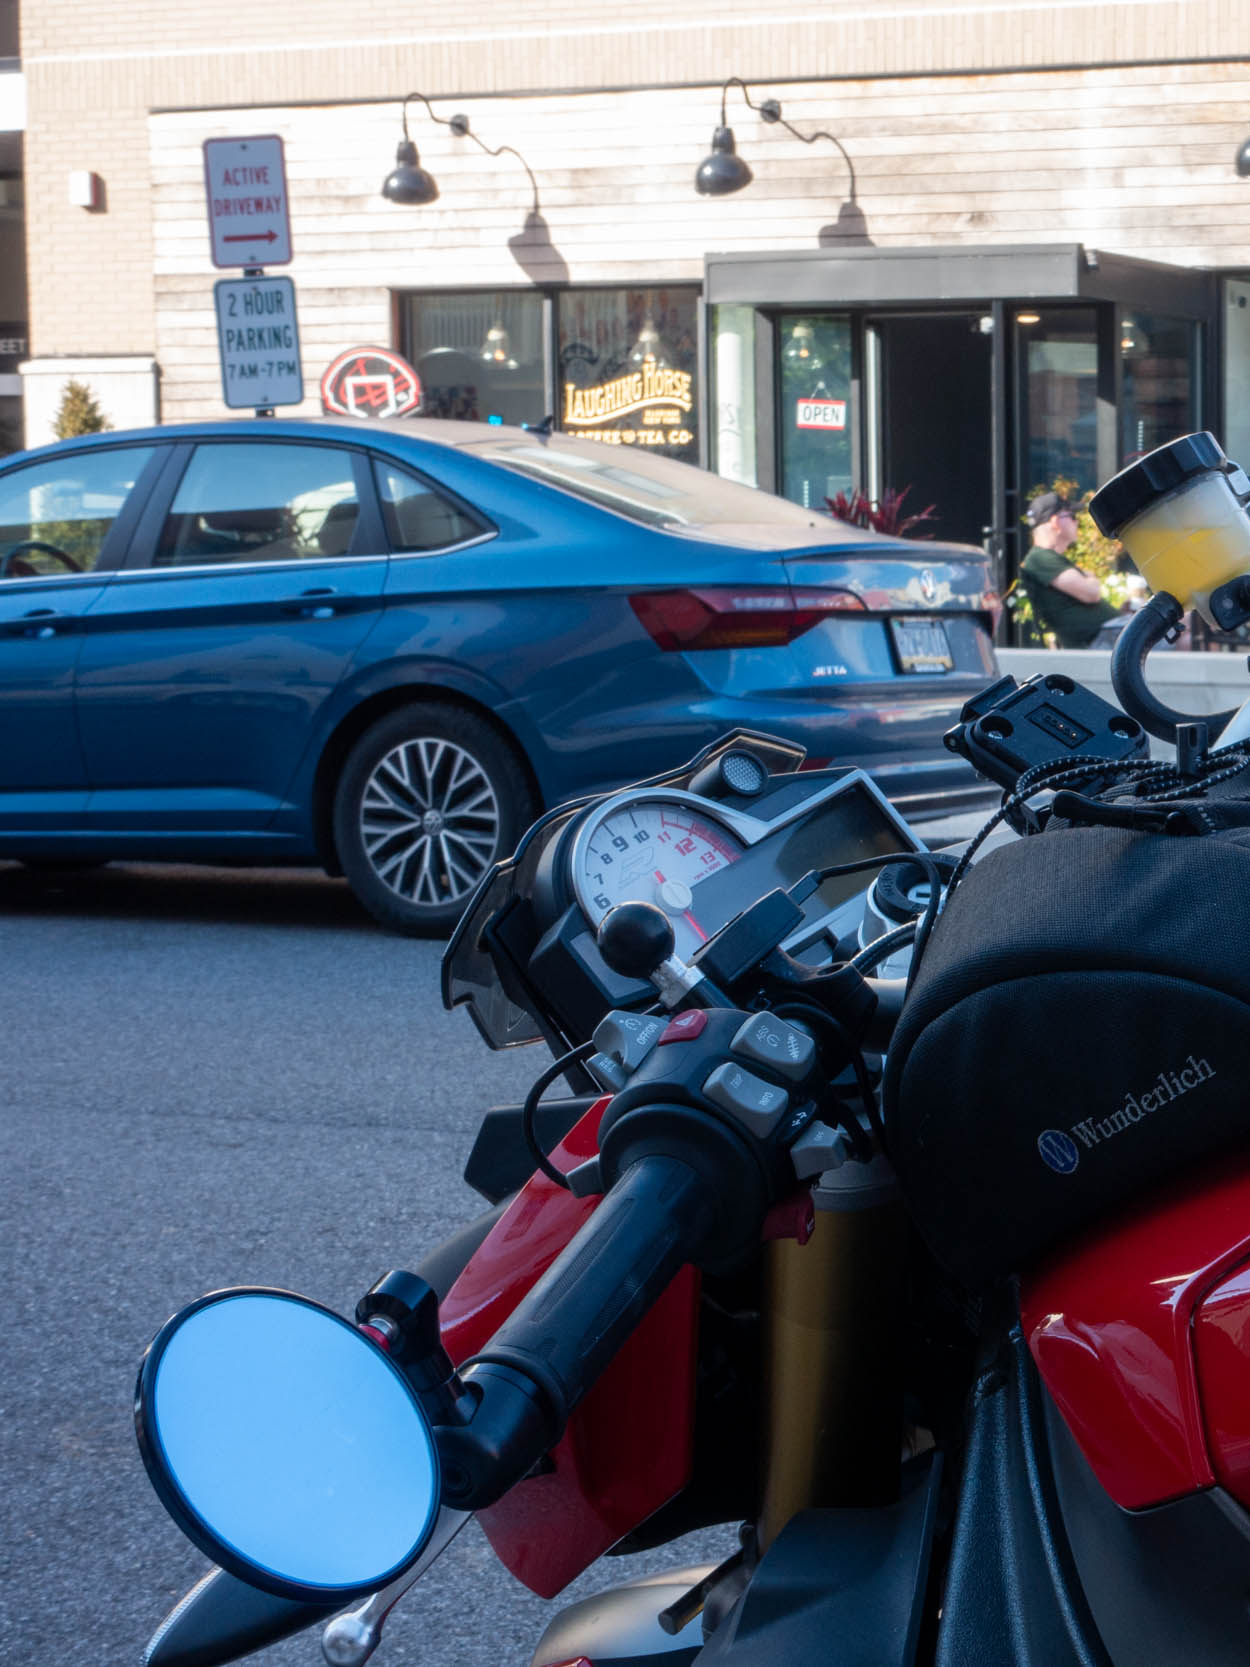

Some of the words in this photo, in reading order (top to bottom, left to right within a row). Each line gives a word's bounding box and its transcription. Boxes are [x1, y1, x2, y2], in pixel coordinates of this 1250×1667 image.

[223, 166, 270, 187] ACTIVE
[214, 196, 282, 217] DRIVEWAY
[227, 292, 238, 317] 2
[243, 289, 285, 316] HOUR
[225, 324, 293, 352] PARKING
[565, 372, 643, 419] LAUGHING
[643, 361, 692, 401] HORSE
[803, 405, 840, 423] OPEN
[637, 431, 665, 444] TEA
[812, 665, 848, 677] JETTA
[612, 836, 629, 852] 9
[633, 829, 650, 844] 10
[657, 831, 672, 843] 11
[674, 837, 697, 856] 12
[600, 853, 614, 865] 8
[700, 851, 716, 865] 13
[593, 873, 604, 885] 7
[593, 893, 611, 910] 6
[1071, 1055, 1217, 1148] Wunderlich
